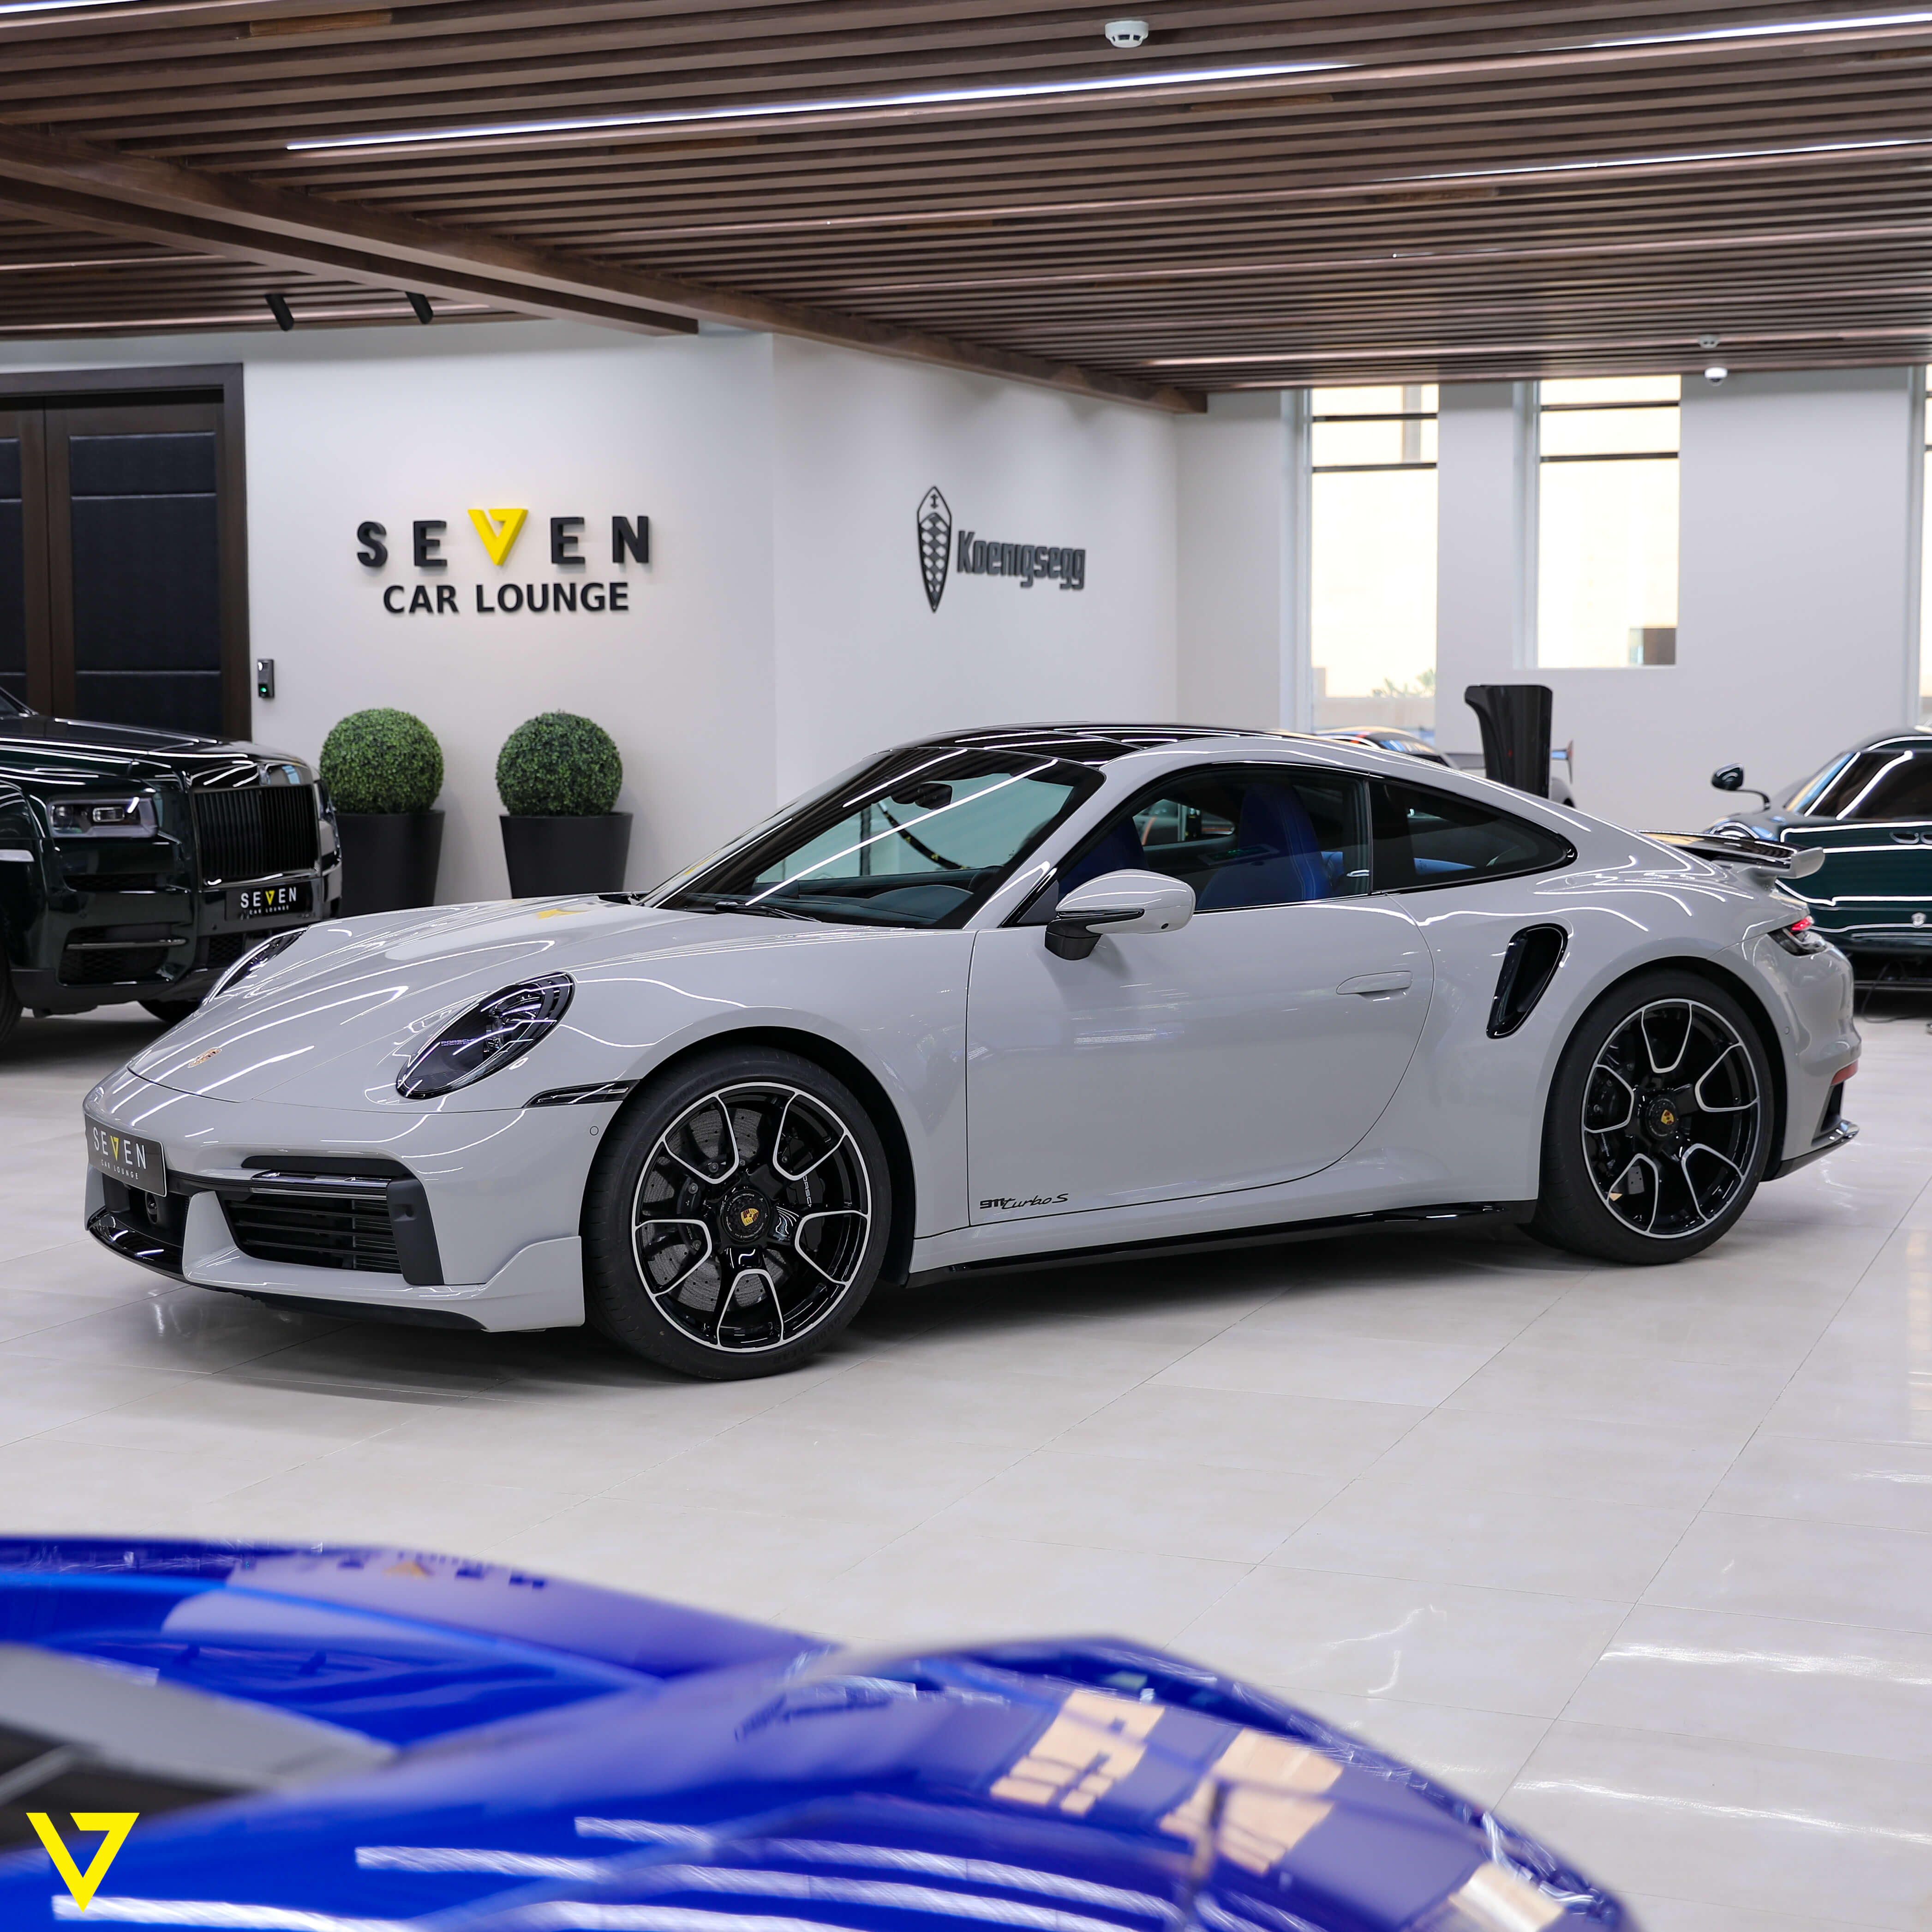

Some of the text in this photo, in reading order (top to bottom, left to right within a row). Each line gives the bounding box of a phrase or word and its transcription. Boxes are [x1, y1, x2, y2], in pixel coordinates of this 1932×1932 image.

[356, 508, 651, 567] SEVEN
[957, 530, 1086, 590] Koenigsegg
[383, 582, 629, 613] CAR LOUNGE
[240, 886, 297, 909] SEVEN
[93, 1127, 147, 1169] SEVEN
[114, 1164, 138, 1180] LOUNGE
